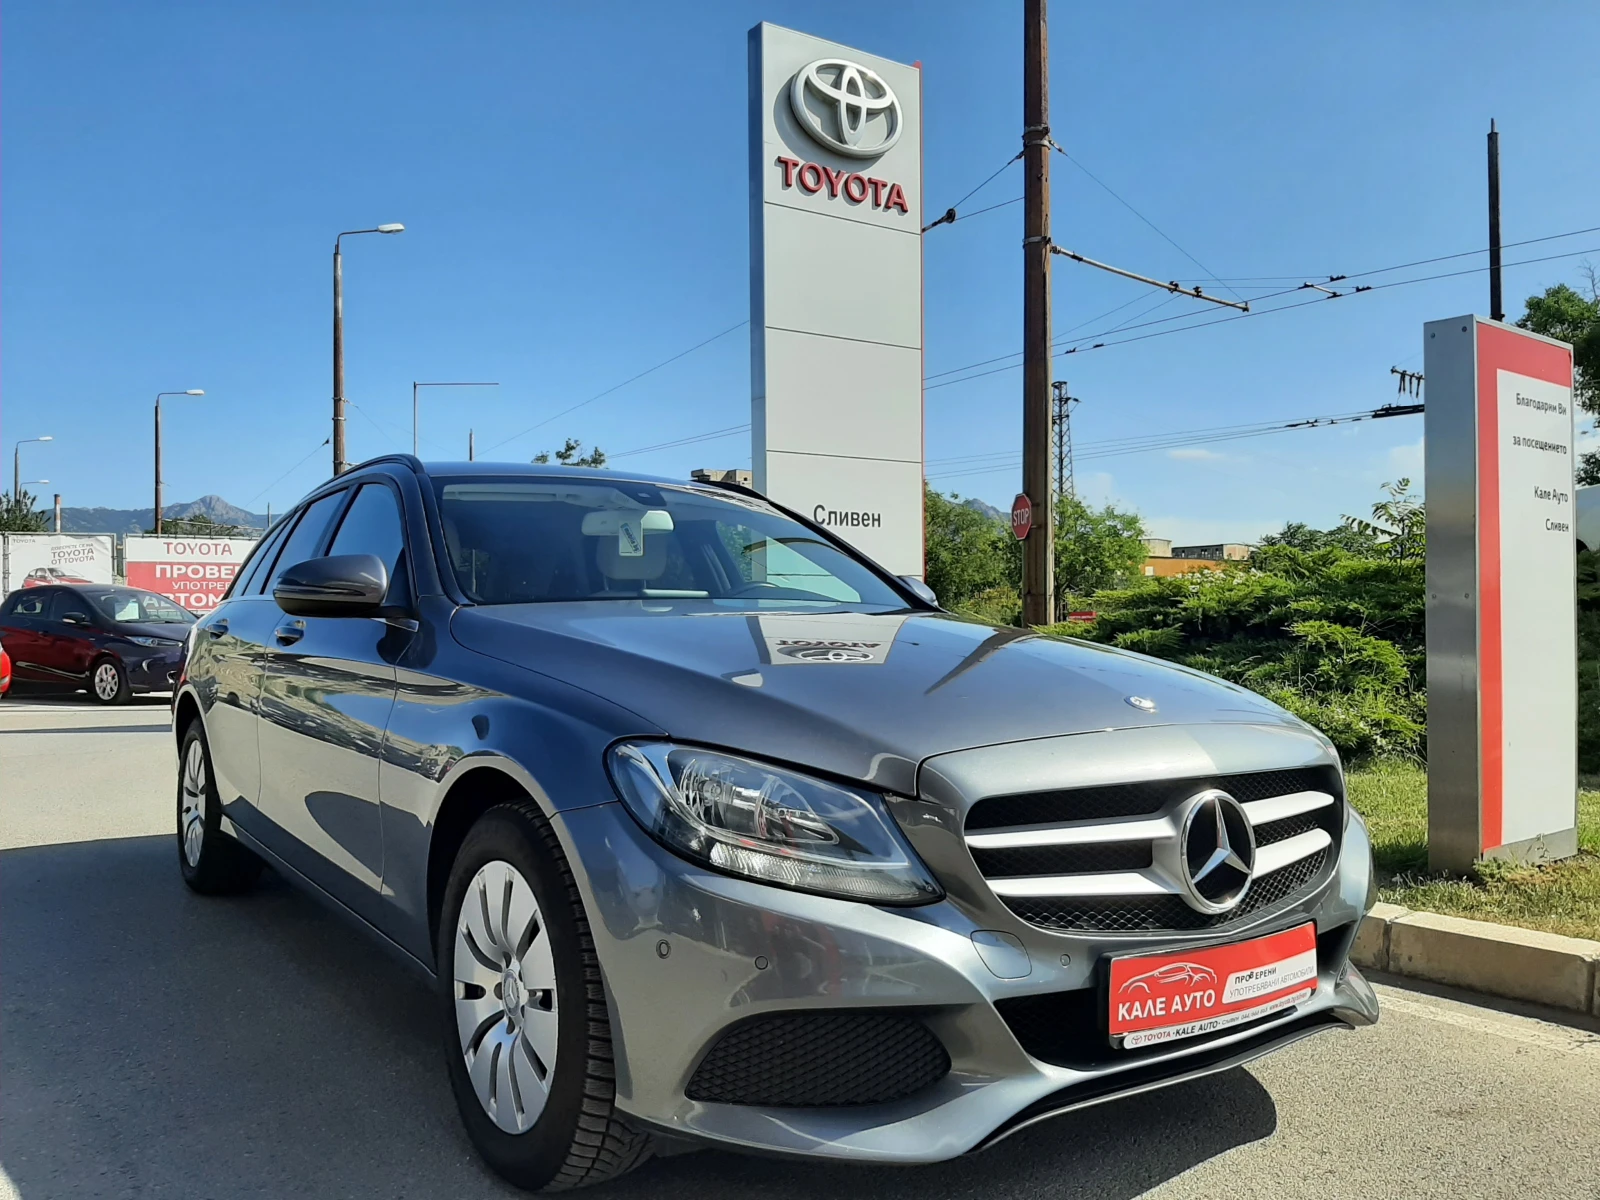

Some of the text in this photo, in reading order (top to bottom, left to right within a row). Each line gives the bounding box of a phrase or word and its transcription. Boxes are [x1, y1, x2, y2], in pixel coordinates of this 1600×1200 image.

[777, 156, 908, 212] TOYOTA
[1516, 392, 1567, 415] Благодарим Ви
[1512, 435, 1567, 455] за посещението
[1534, 486, 1568, 505] Кале Ауто
[813, 504, 881, 528] Сливен
[1013, 508, 1029, 526] STOP
[1545, 518, 1569, 532] Сливен
[51, 548, 95, 559] TOYOTA
[163, 541, 233, 556] TOYOTA
[63, 555, 95, 564] TOYOTA
[1229, 965, 1315, 999] УПОТРЕБЯВАНИ АВТОМОБИЛИ
[1234, 967, 1277, 985] ПРОВЕРЕНИ
[1118, 989, 1215, 1021] КАЛЕ АУТО
[1143, 1031, 1171, 1042] TOYOTA
